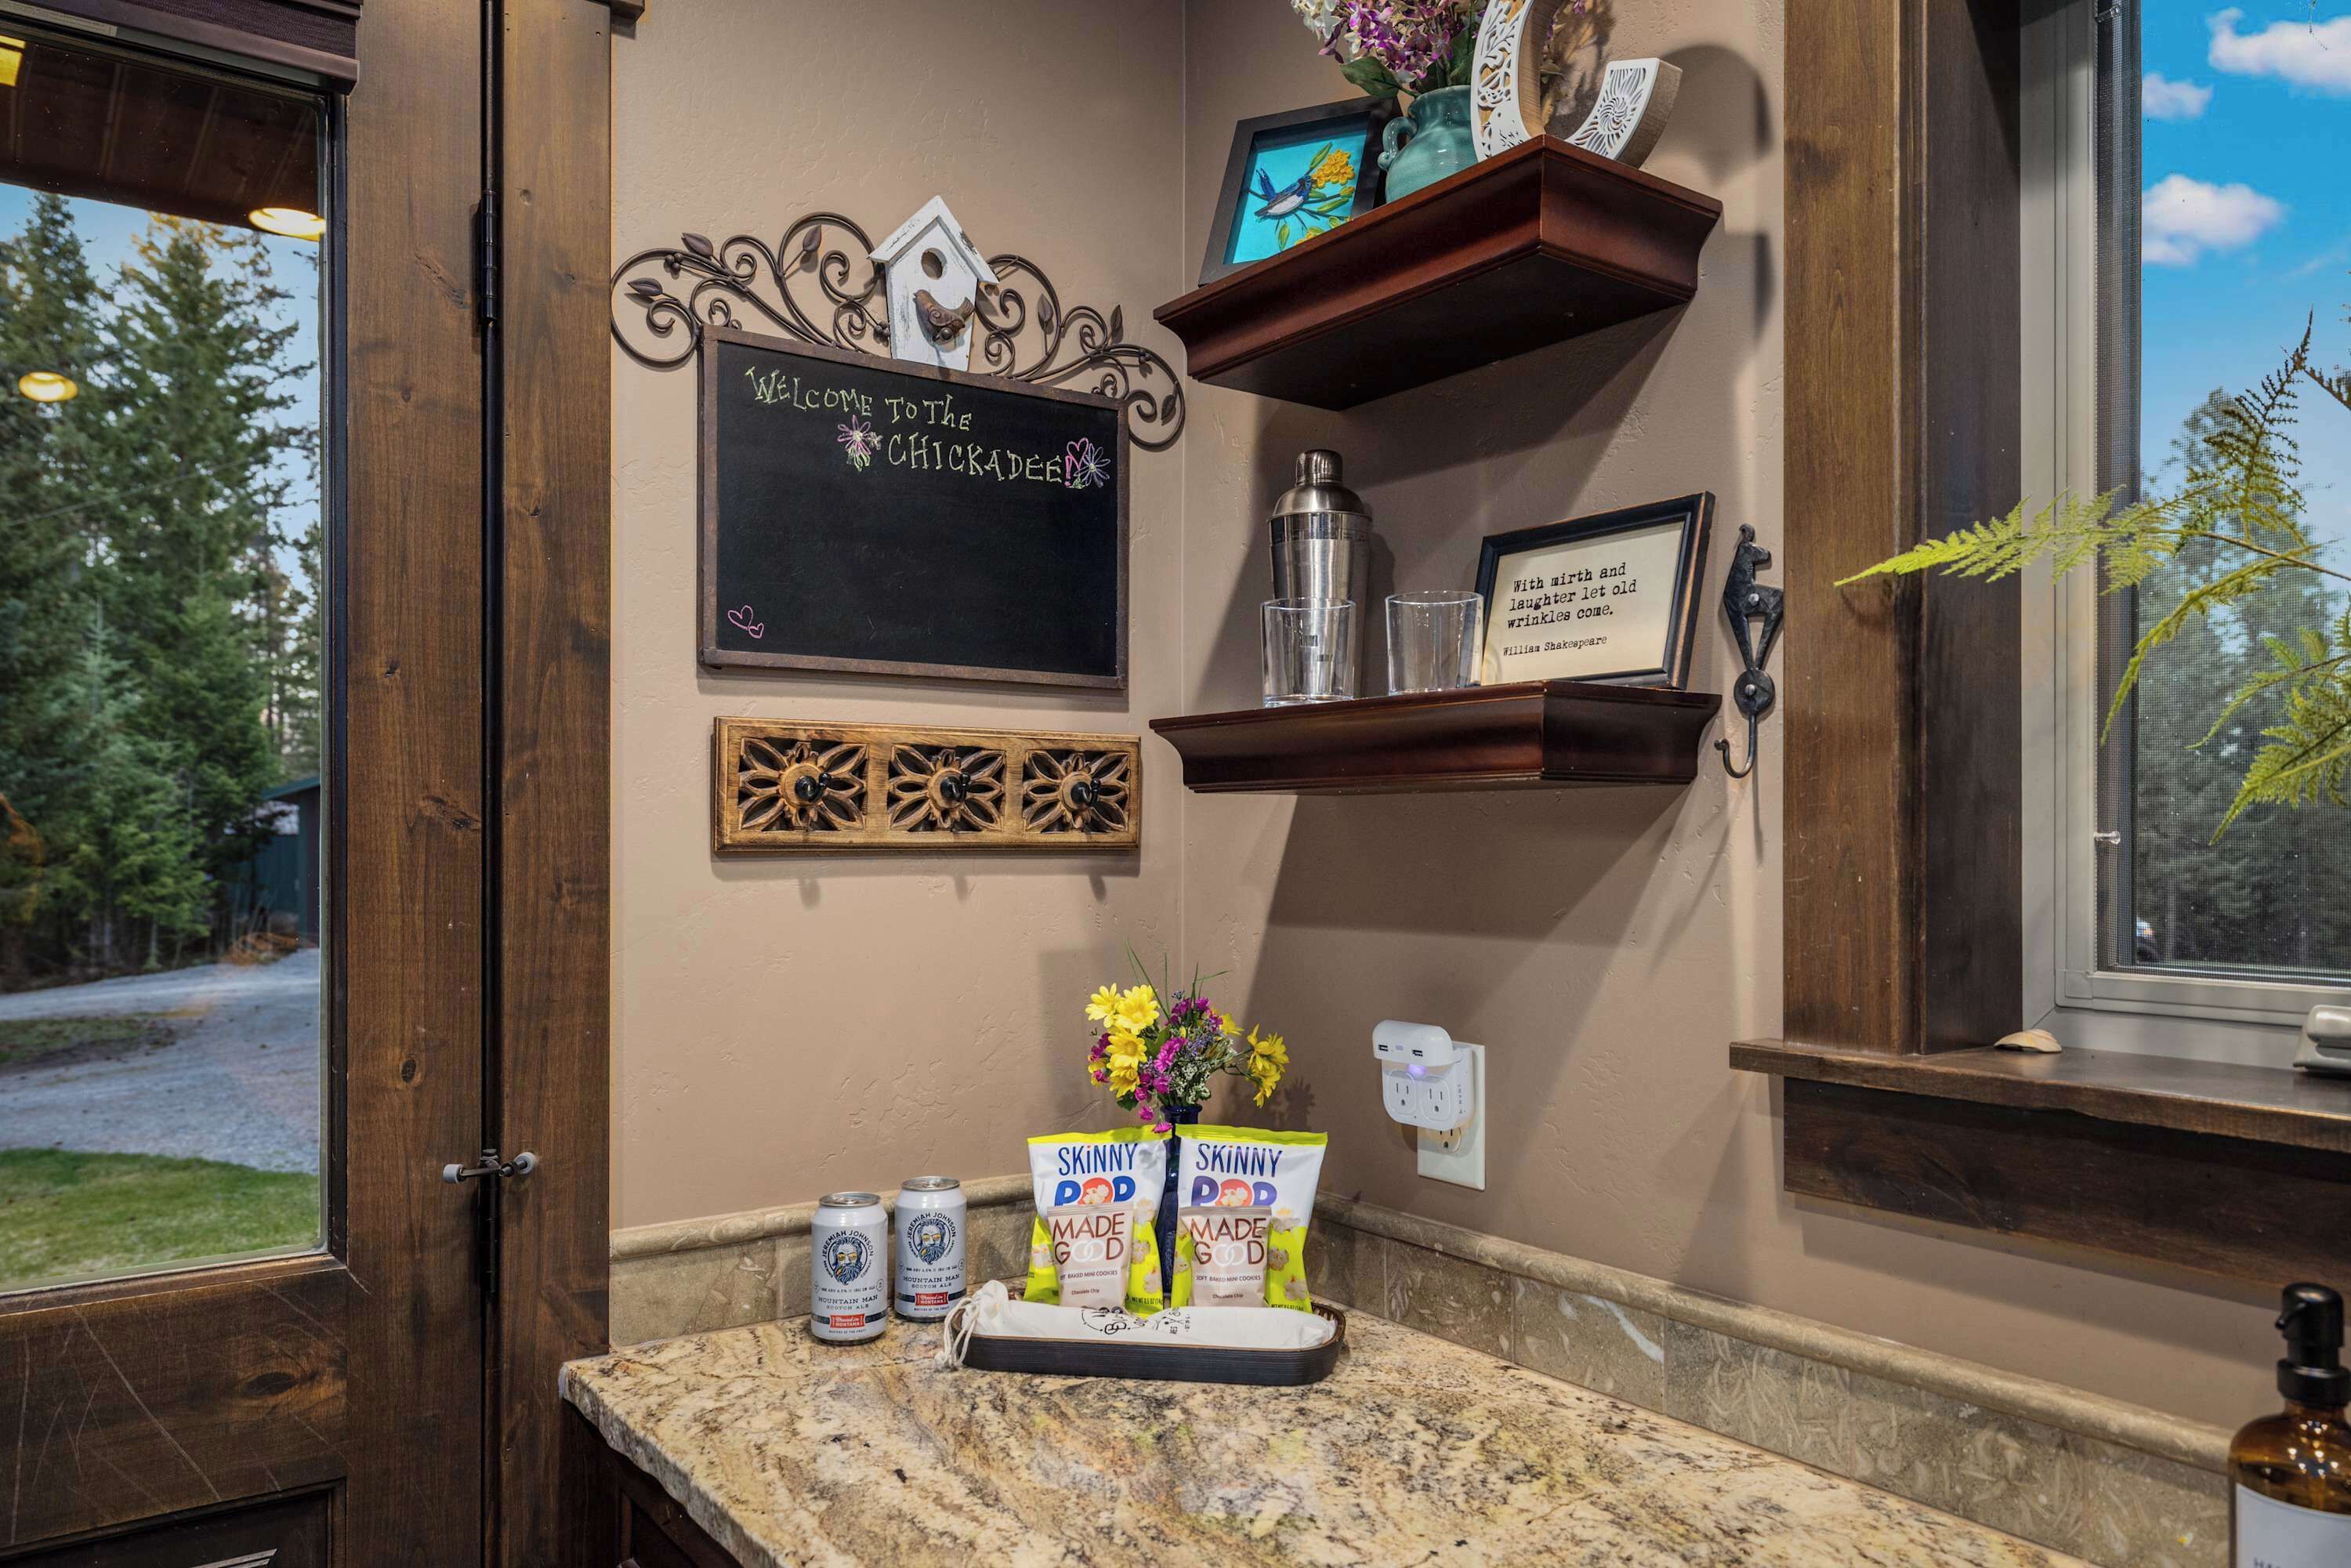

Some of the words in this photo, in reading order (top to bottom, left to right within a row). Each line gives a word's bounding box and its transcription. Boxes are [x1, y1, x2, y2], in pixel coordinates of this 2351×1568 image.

[745, 366, 872, 416] WELCOME
[1514, 577, 1544, 592] With
[1551, 569, 1592, 586] mirth
[1599, 562, 1626, 578] and
[1509, 592, 1576, 610] laughter
[1581, 585, 1606, 600] let
[1612, 580, 1636, 596] old
[1508, 610, 1570, 628] wrinkles
[1577, 604, 1614, 619] come.
[1503, 645, 1540, 656] William
[1545, 636, 1607, 651] Shakespeare
[907, 1212, 931, 1239] JEREMIAH
[933, 1212, 956, 1237] JOHNSON
[1053, 1213, 1125, 1241] MADE
[1190, 1218, 1266, 1241] MADE
[822, 1230, 846, 1258] JEREMIAH
[849, 1230, 874, 1256] JOHNSON
[1055, 1237, 1124, 1265] GOOD
[1194, 1240, 1265, 1267] GOOD
[945, 1273, 960, 1282] MAN
